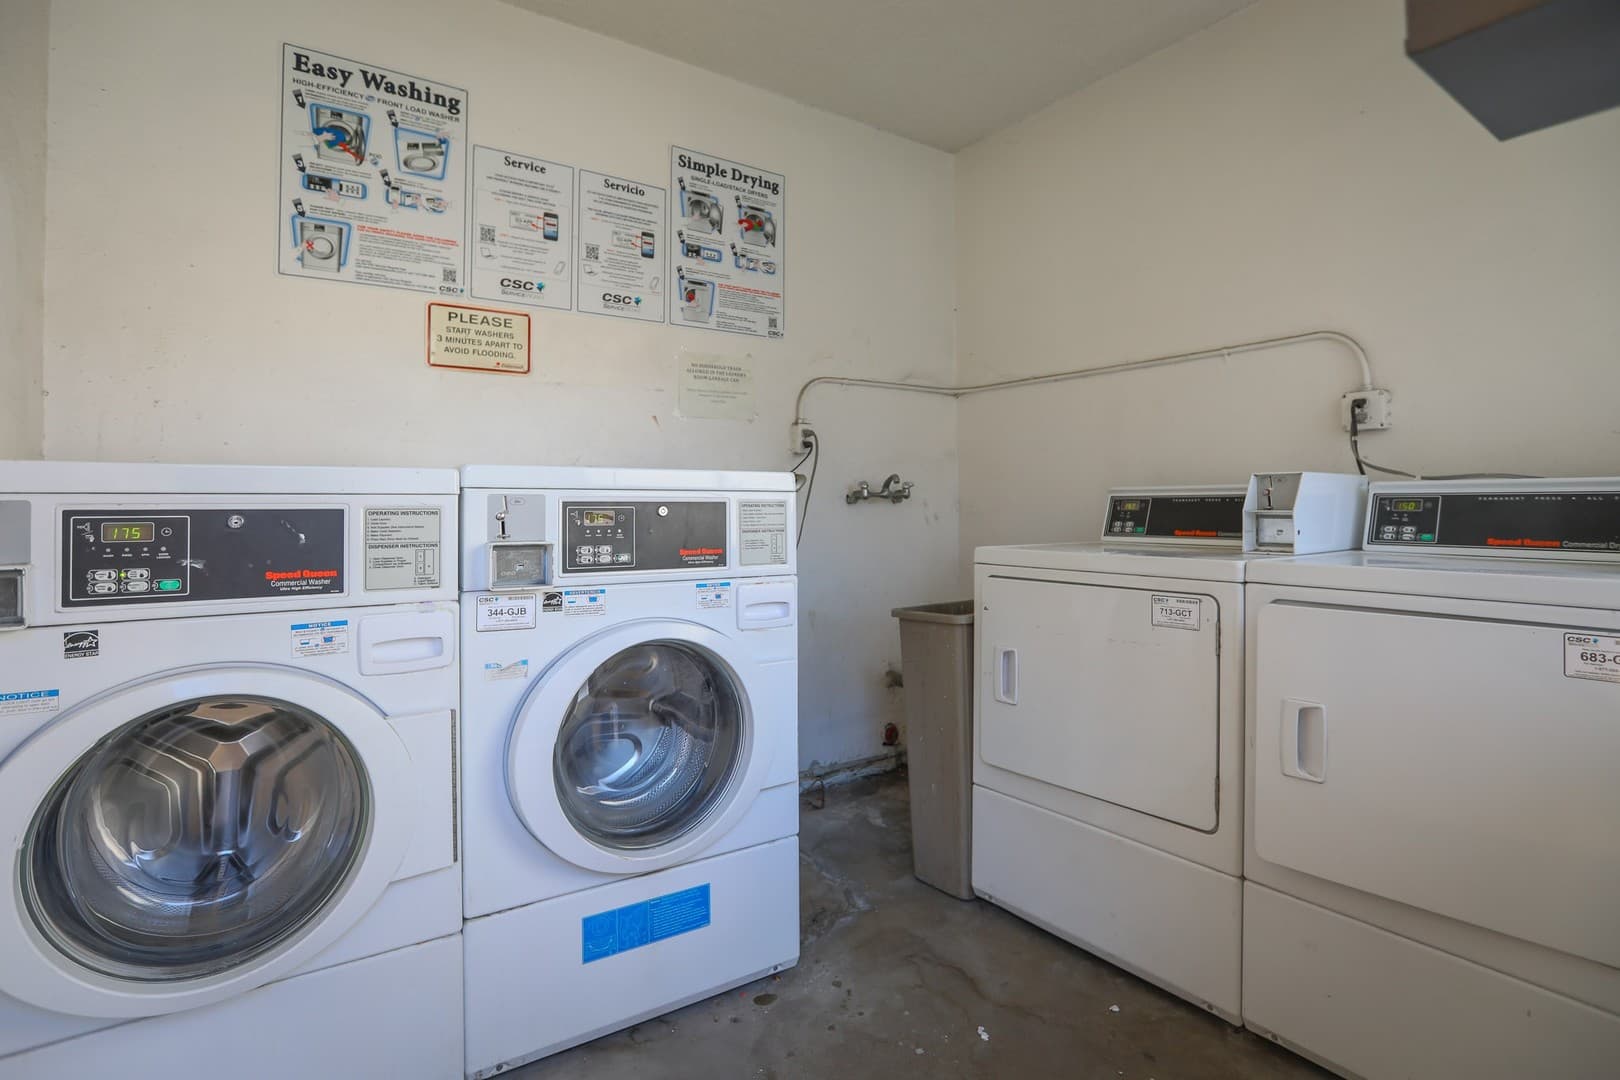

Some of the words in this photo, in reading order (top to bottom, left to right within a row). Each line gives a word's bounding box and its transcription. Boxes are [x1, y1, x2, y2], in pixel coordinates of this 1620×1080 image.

[292, 52, 354, 87] Easy
[359, 69, 461, 115] Washing
[292, 77, 364, 100] HIGH-EFFICIENCY
[377, 98, 403, 109] FRONT
[405, 105, 427, 115] LOAD
[429, 111, 460, 122] WASHER
[504, 155, 546, 174] Service
[678, 154, 728, 178] Simple
[731, 167, 779, 195] Drying
[603, 178, 645, 196] Servicio
[500, 278, 535, 290] CSC
[602, 292, 632, 304] CSC
[448, 311, 513, 328] PLEASE
[446, 326, 471, 335] START
[474, 329, 514, 339] WASHERS
[436, 334, 442, 342] 3
[445, 336, 482, 346] MINUTES
[485, 340, 510, 349] APART
[444, 346, 470, 355] AVOID
[112, 527, 141, 539] 175
[1487, 538, 1522, 546] Speed
[1523, 538, 1560, 547] Queen
[1562, 540, 1608, 548] Commercial
[265, 570, 301, 580] Speed
[302, 569, 338, 578] Queen
[270, 579, 307, 587] Commercial
[487, 607, 527, 617] 344-GJB
[1160, 607, 1192, 617] 713-GCT
